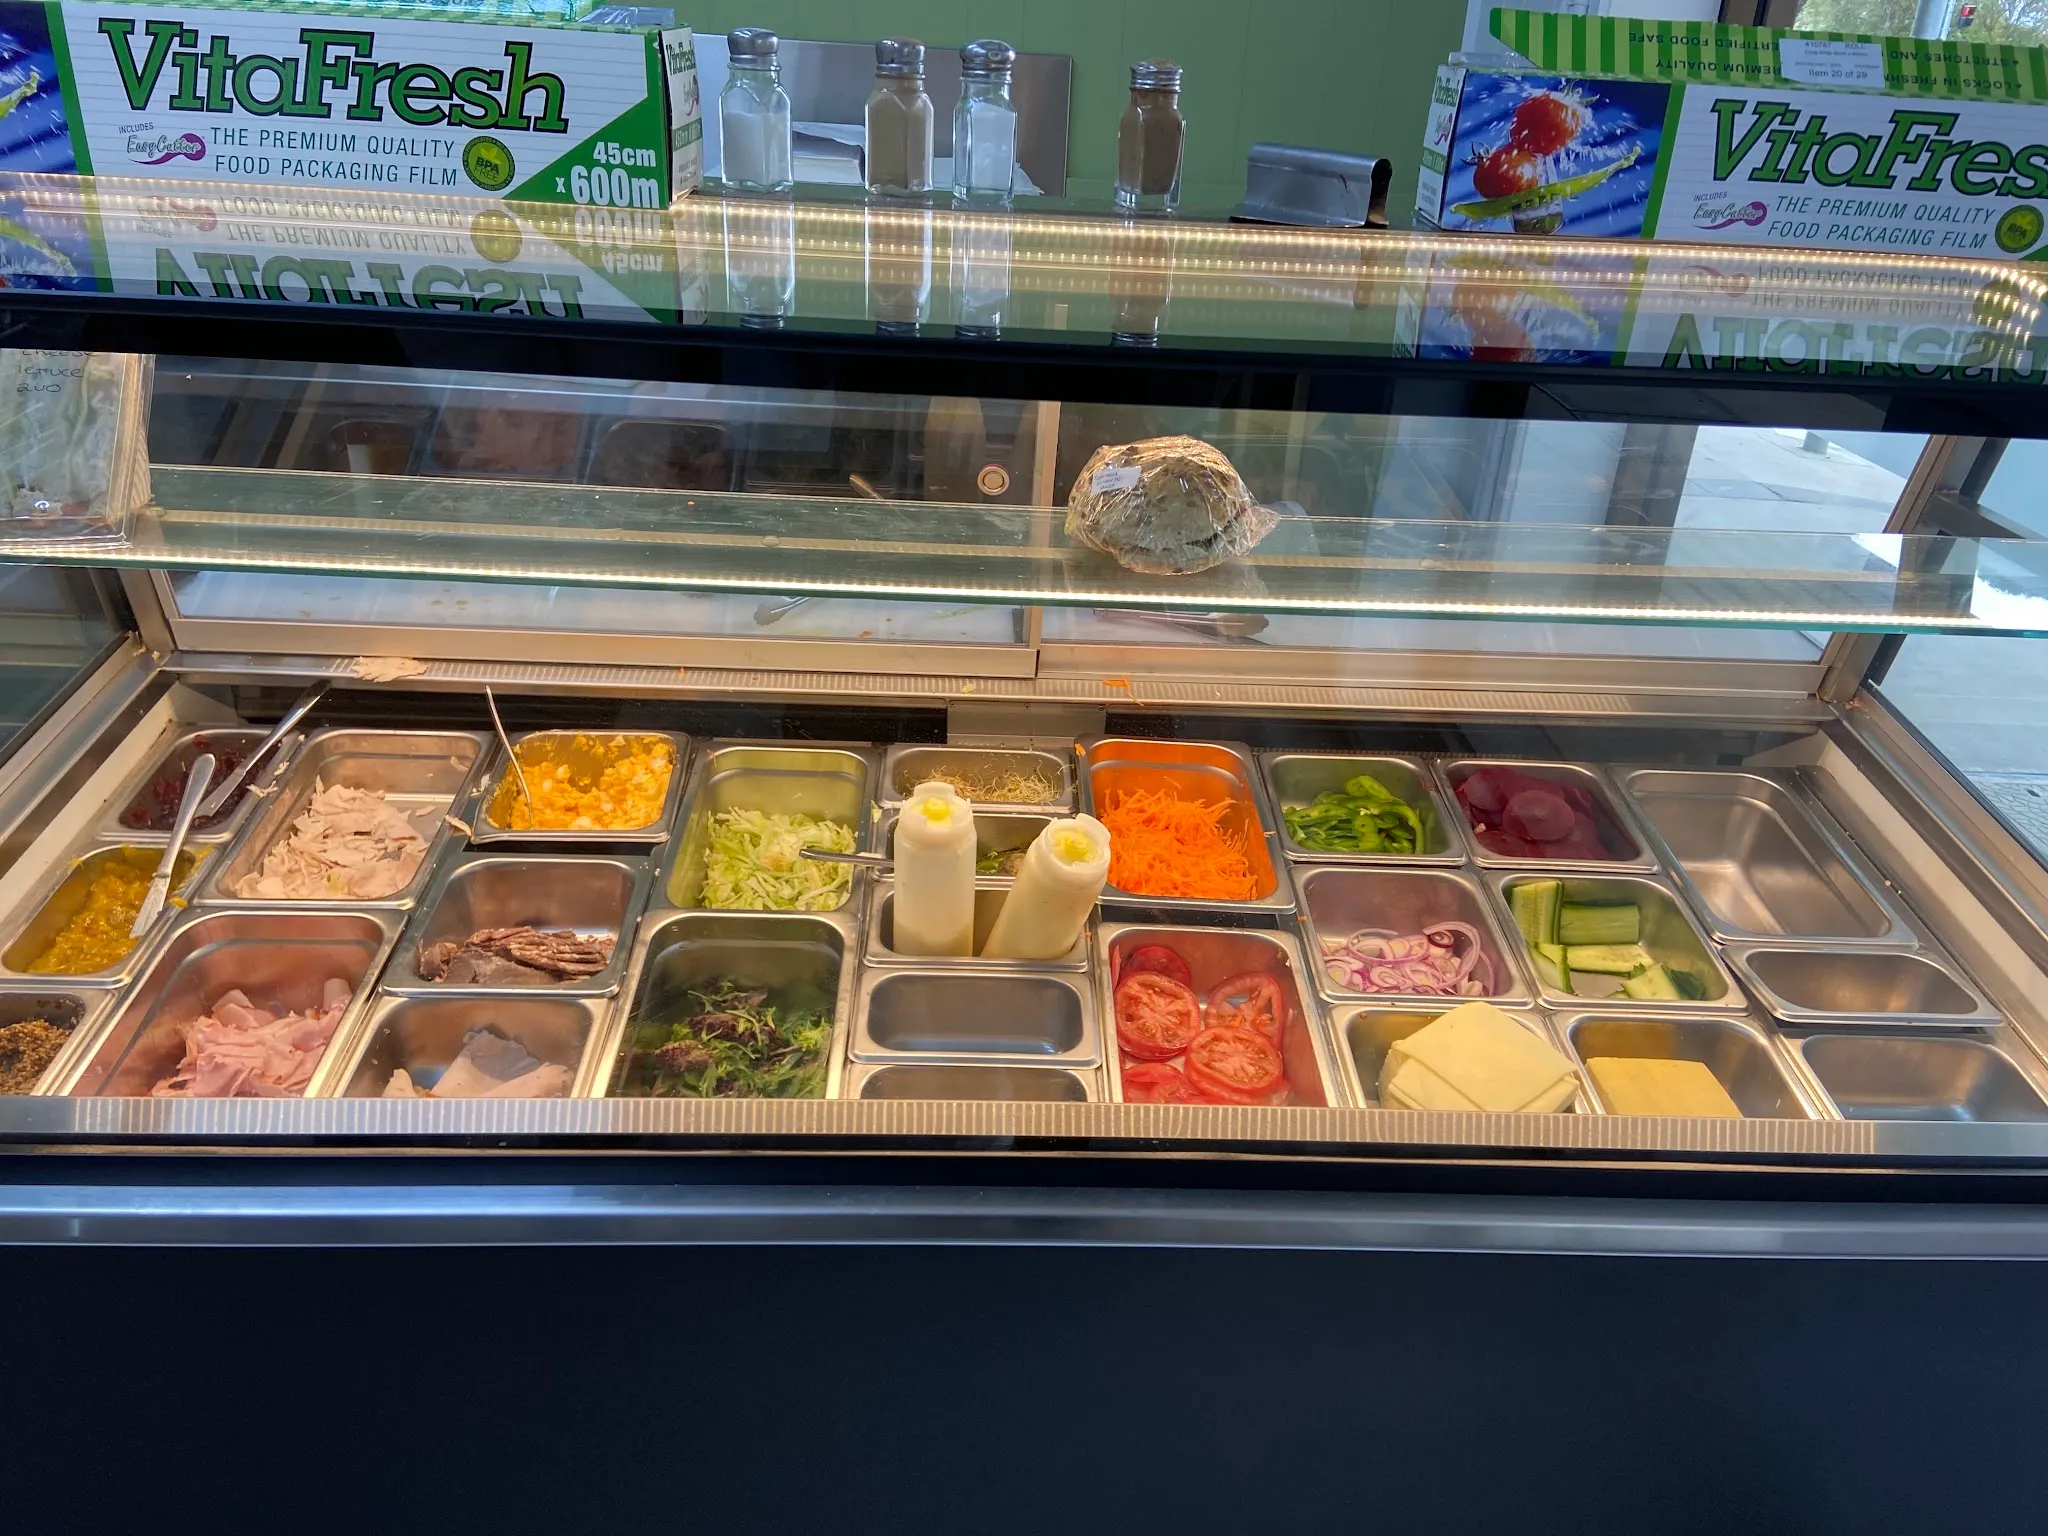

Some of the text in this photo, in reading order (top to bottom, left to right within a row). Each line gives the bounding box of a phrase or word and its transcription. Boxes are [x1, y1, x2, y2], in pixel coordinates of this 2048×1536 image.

[1629, 32, 1779, 51] SAFE FOOD ERTIFIED
[1656, 59, 1717, 72] QUALITY
[1723, 63, 1781, 76] REMIUM
[1890, 51, 2008, 66] AND STRETCHES
[98, 17, 569, 134] VitaFresh
[1809, 69, 1867, 79] Item 20 of 29
[1884, 73, 2012, 91] FRESHN IN LOCKS
[118, 122, 154, 134] INCLUDES
[210, 127, 455, 158] THE PREMIUM QUALITY
[1711, 98, 2048, 199] VitaFres
[593, 141, 657, 168] 45cm
[215, 155, 270, 175] FOOD
[281, 158, 399, 183] PACKAGING
[409, 166, 457, 186] FILM
[473, 165, 500, 183] FREE
[476, 156, 499, 174] BPA
[555, 177, 566, 193] x
[570, 164, 660, 209] 600m
[1693, 191, 1727, 202] INCLUDES
[1776, 195, 1996, 225] THE PREMIUM QUALITY
[1767, 220, 1820, 239] FOOD
[1827, 224, 1935, 246] PACKAGING
[1940, 231, 1988, 249] FILM
